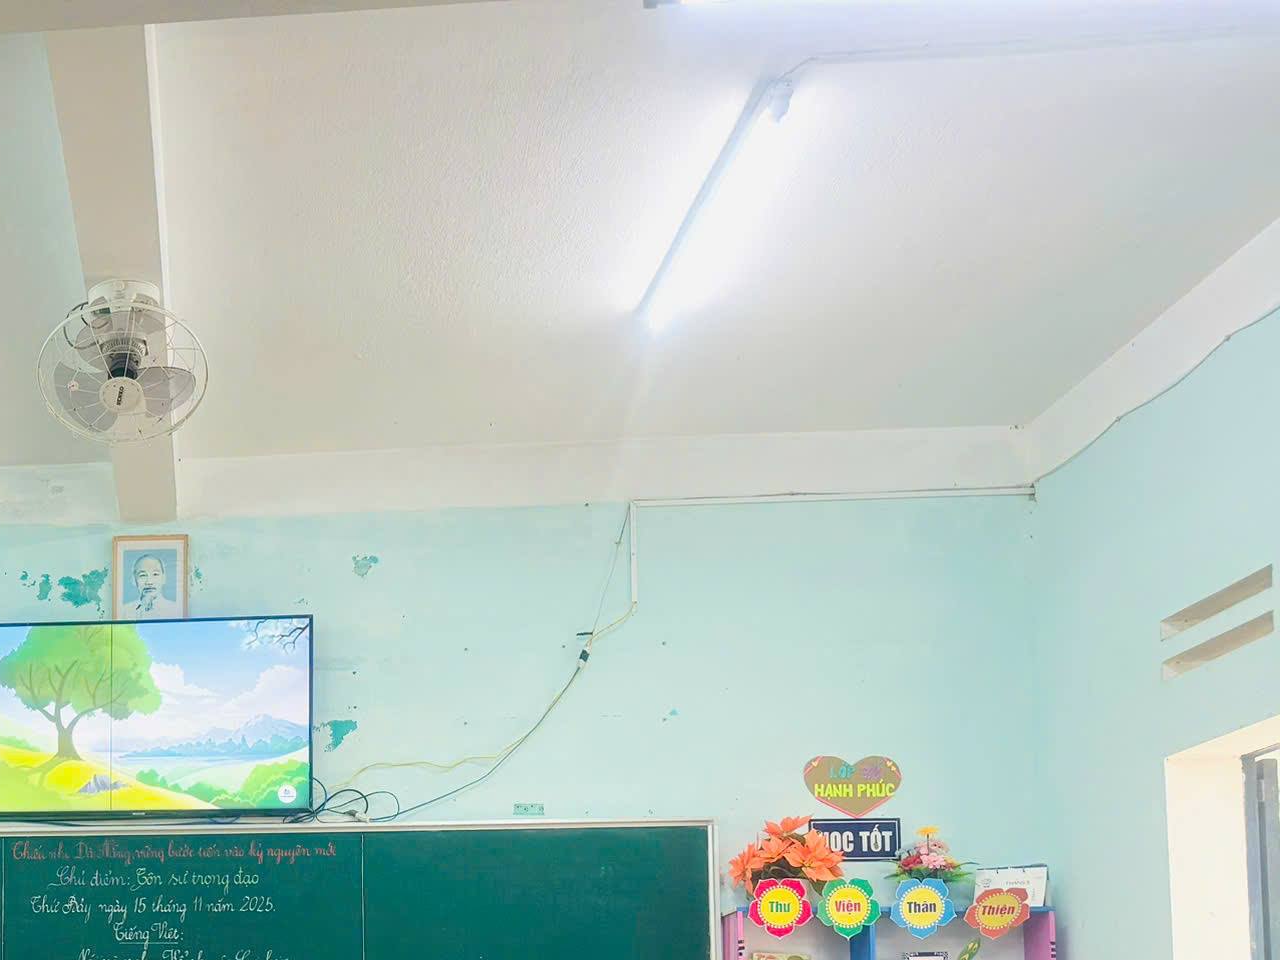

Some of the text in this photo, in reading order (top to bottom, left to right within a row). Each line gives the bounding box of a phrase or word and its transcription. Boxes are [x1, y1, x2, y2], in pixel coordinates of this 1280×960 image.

[814, 778, 896, 800] HẠNH PHÚC
[859, 823, 893, 852] TỐT
[233, 866, 260, 888] đạo
[133, 896, 147, 913] 15
[151, 894, 187, 922] tháng
[834, 898, 862, 915] Viện
[981, 903, 1016, 918] Thiện
